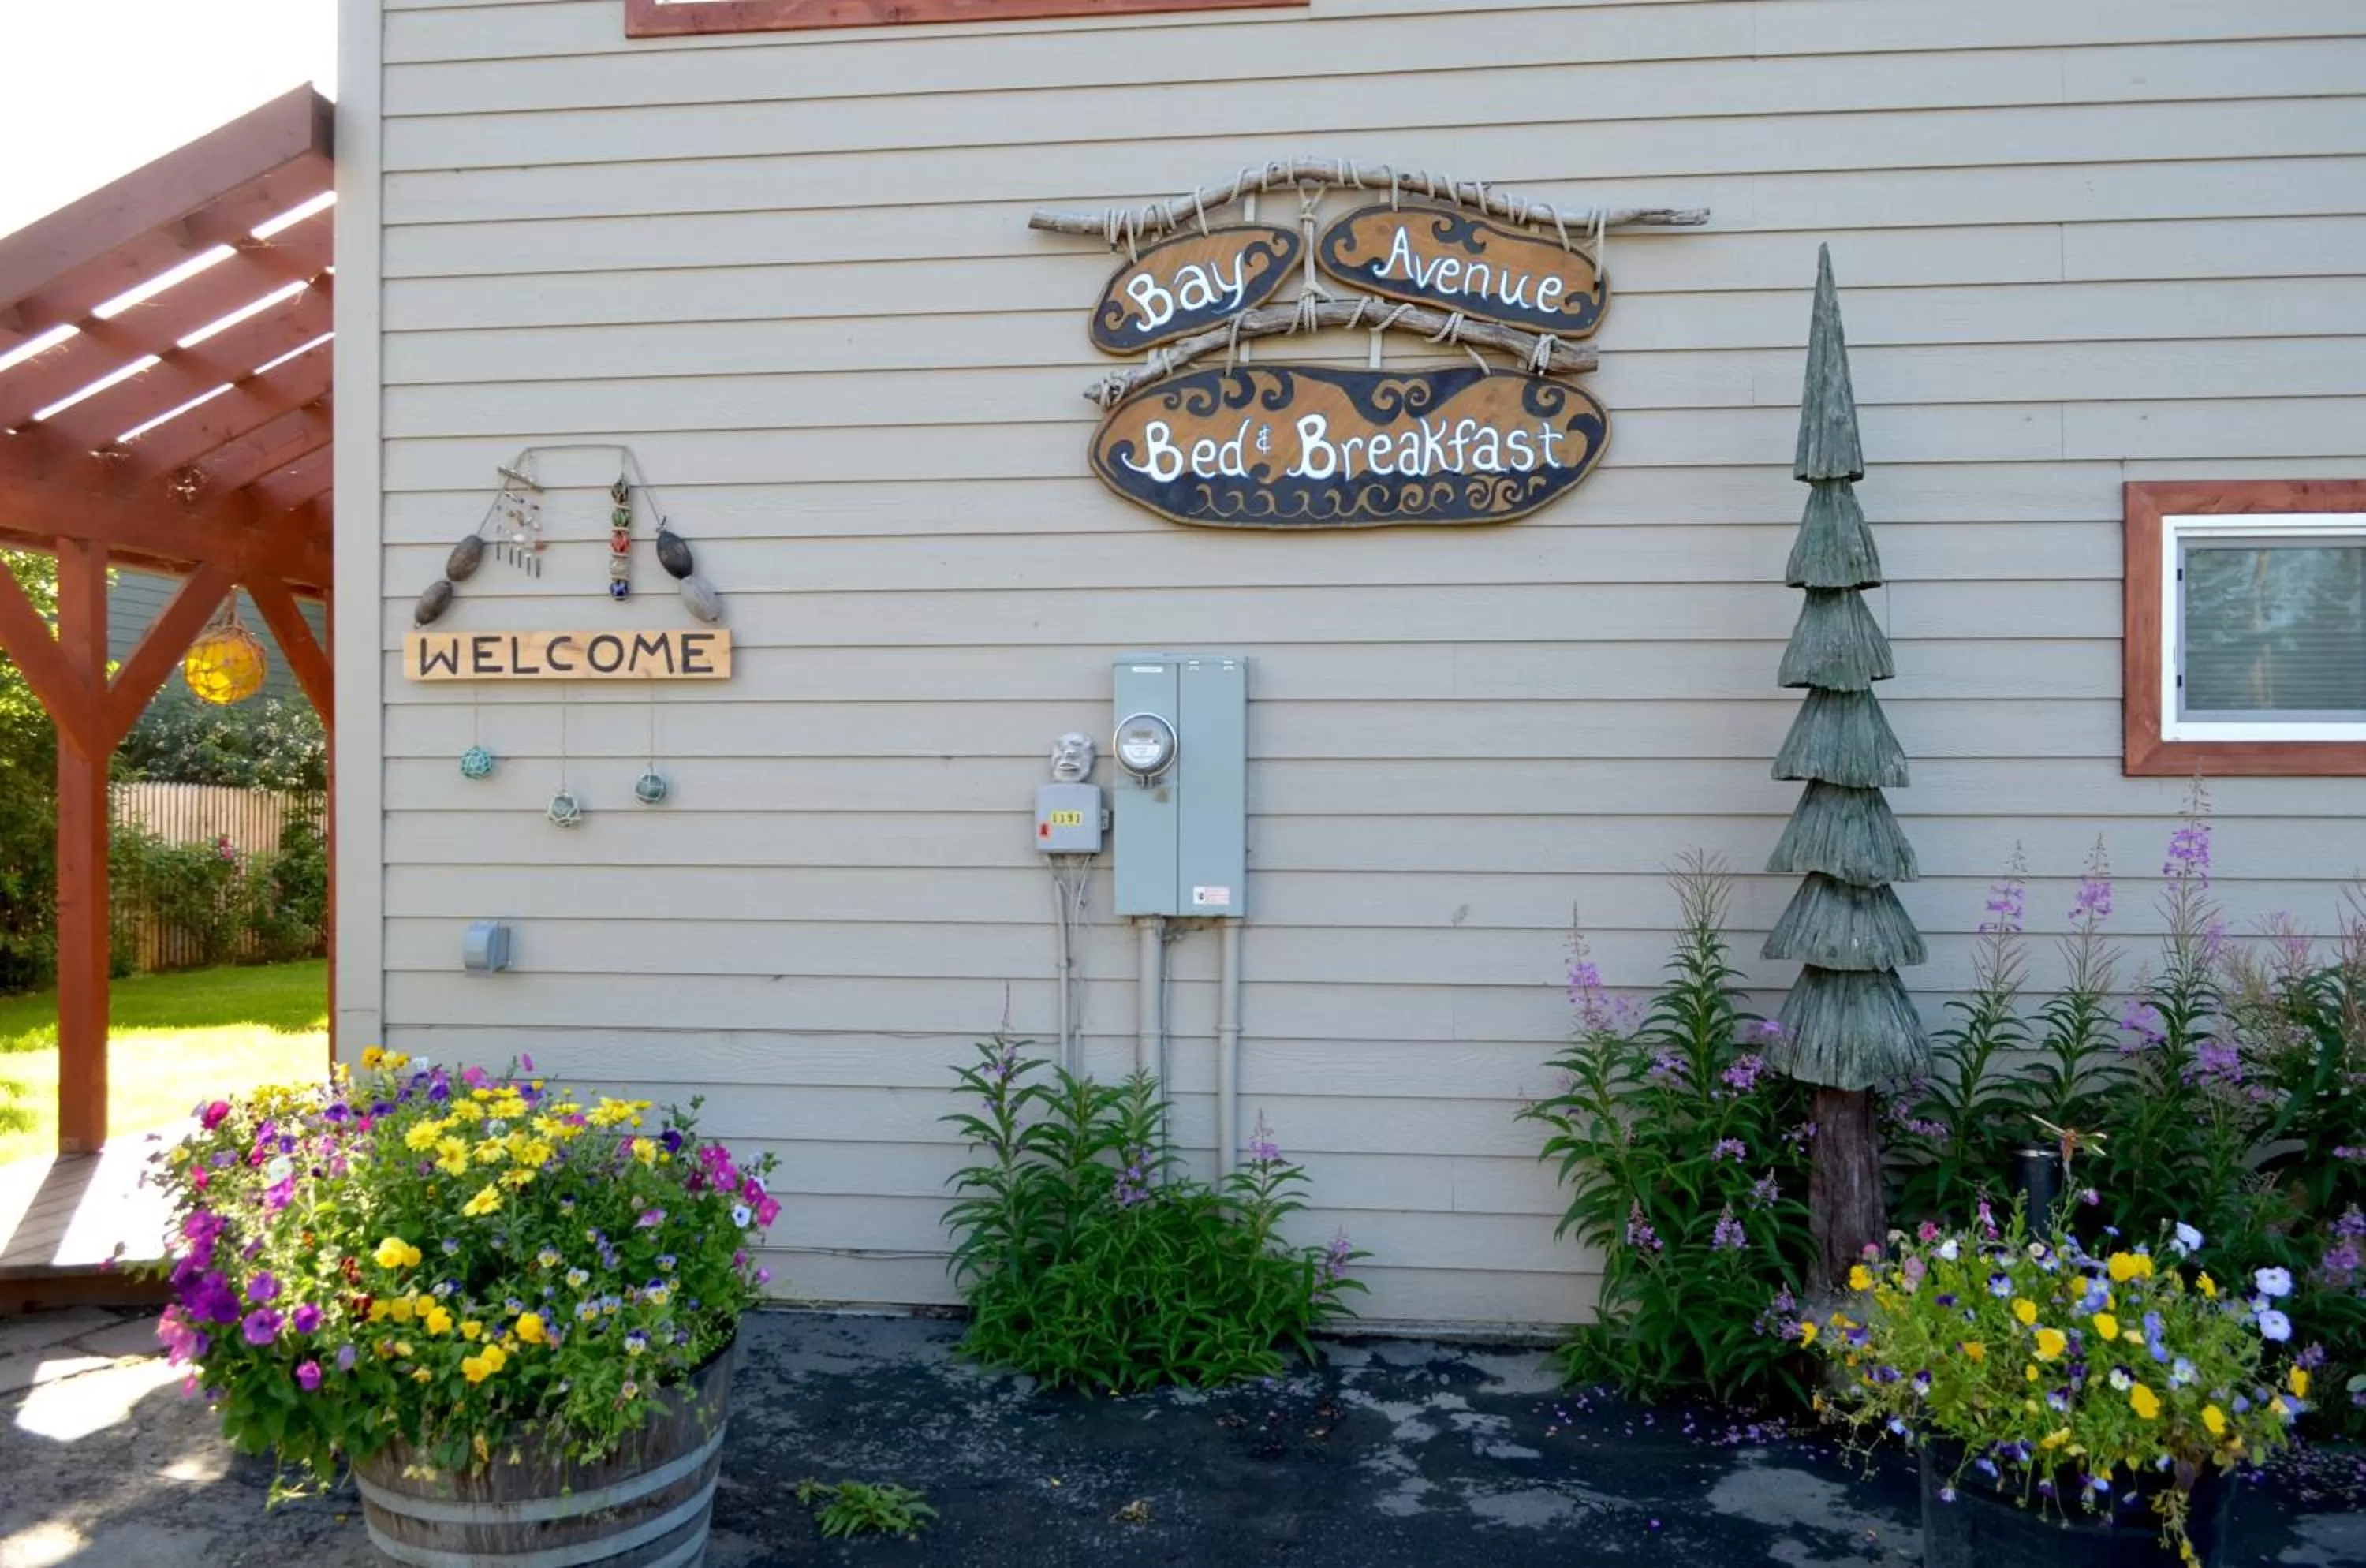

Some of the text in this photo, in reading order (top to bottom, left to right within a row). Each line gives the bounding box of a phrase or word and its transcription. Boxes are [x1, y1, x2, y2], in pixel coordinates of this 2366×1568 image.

[1125, 252, 1246, 332] Bay
[1372, 226, 1565, 314] Avenue
[1122, 413, 1566, 483] Bed & Breakfast
[420, 633, 715, 676] WELCOME
